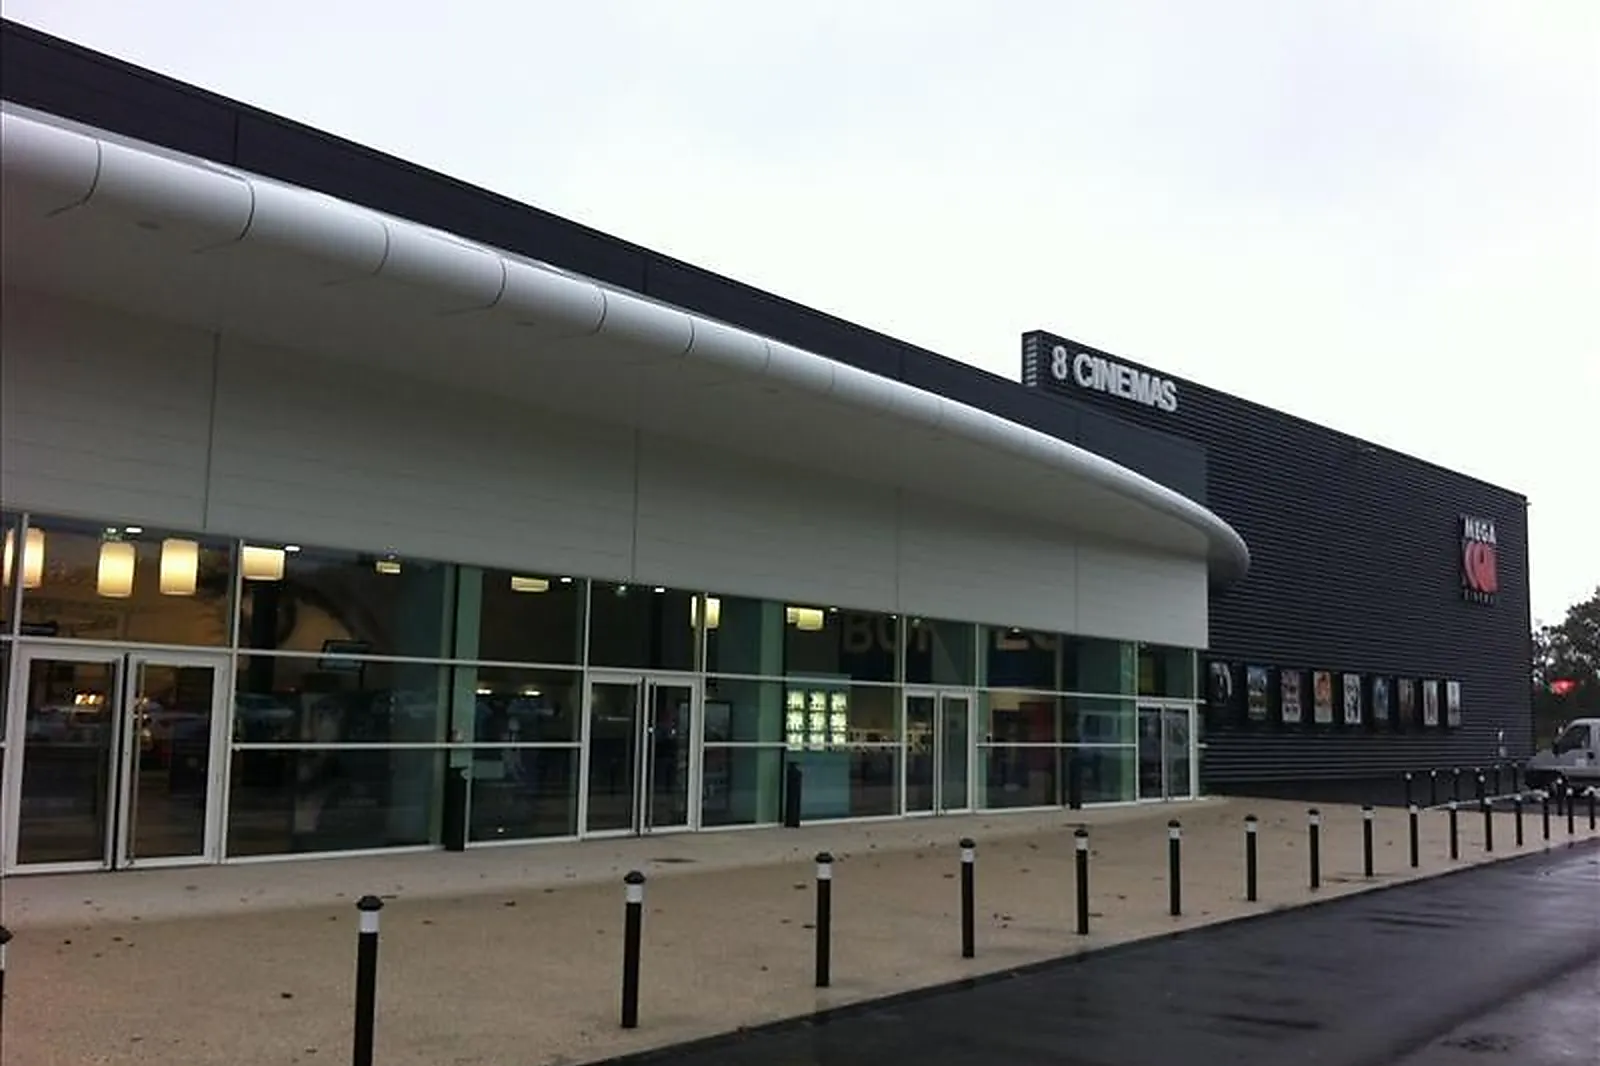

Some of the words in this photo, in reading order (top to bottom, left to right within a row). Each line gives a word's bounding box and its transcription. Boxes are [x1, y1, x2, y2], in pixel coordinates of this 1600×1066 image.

[1051, 345, 1068, 380] 8
[1073, 353, 1178, 412] CINEMAS
[1465, 515, 1496, 544] MEGA
